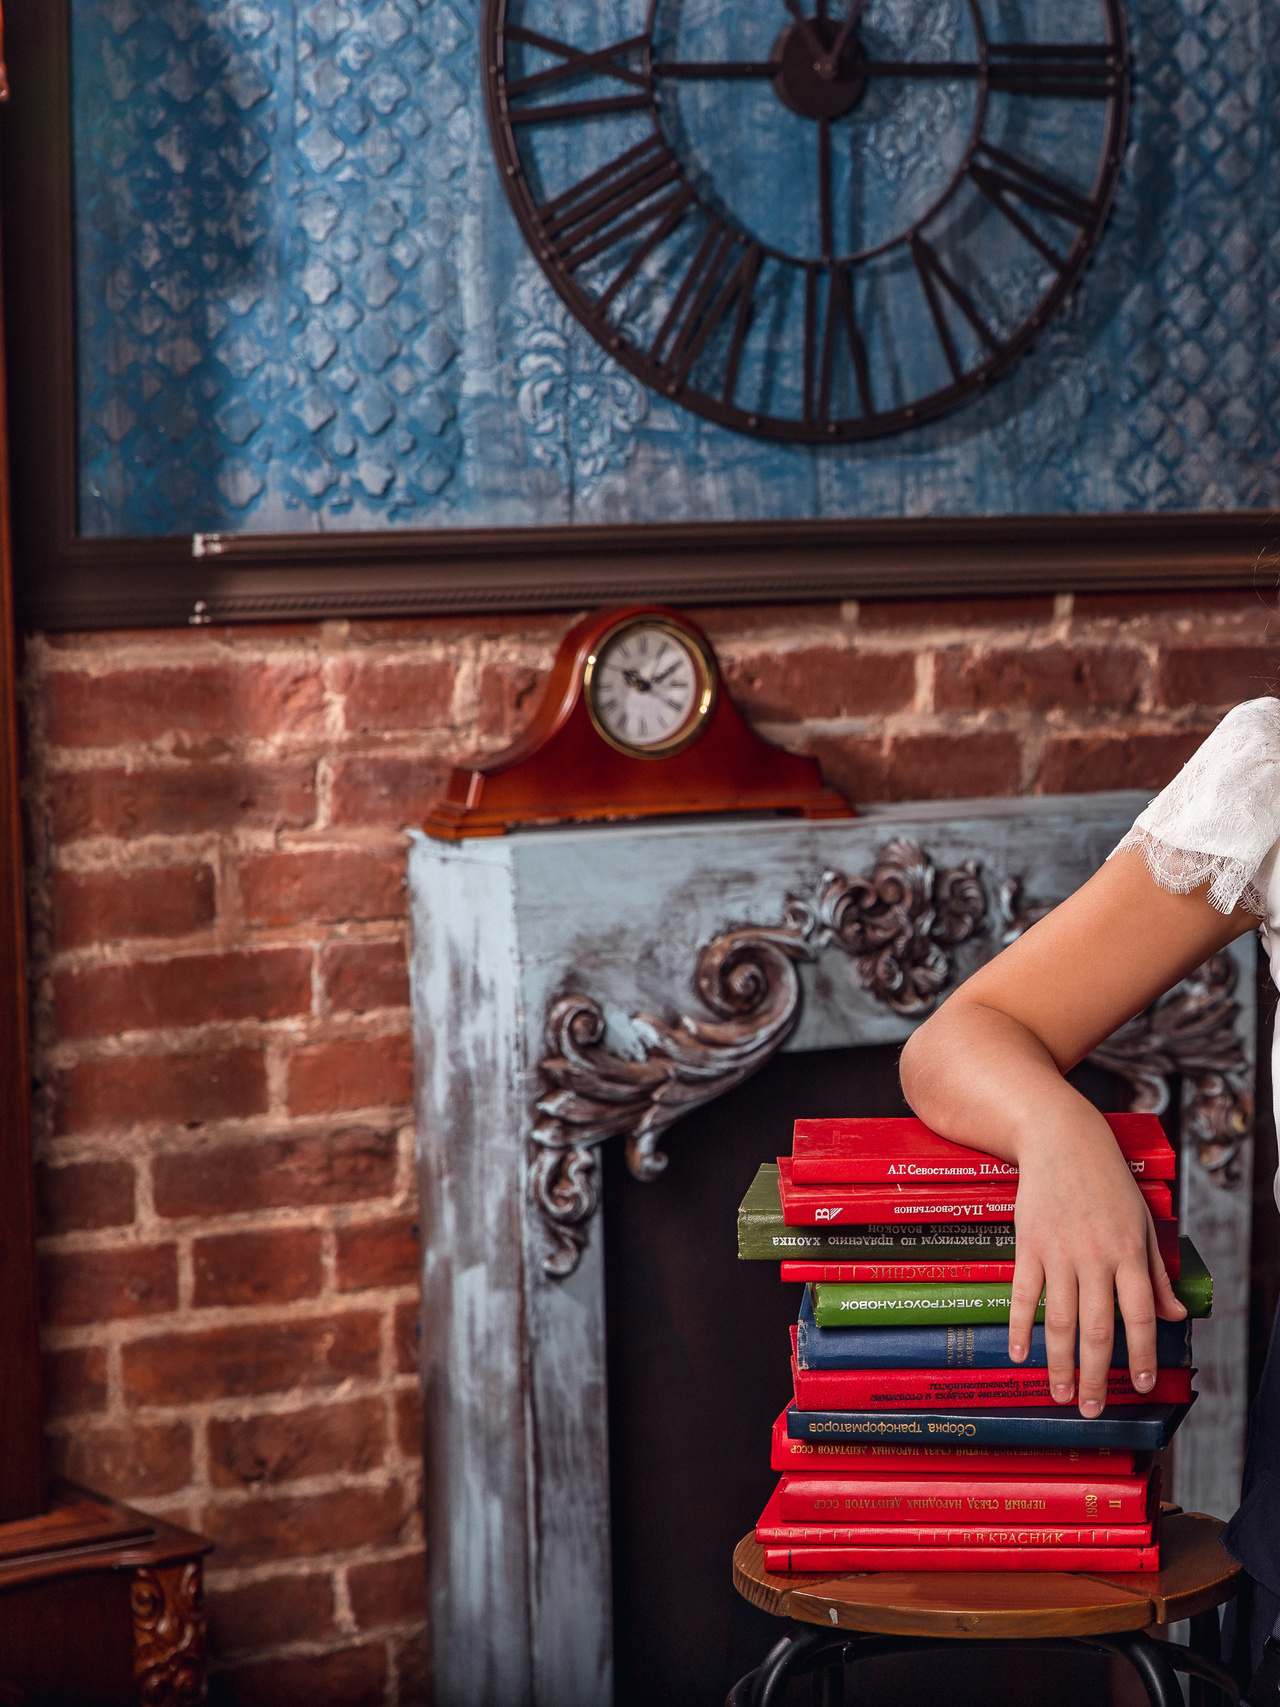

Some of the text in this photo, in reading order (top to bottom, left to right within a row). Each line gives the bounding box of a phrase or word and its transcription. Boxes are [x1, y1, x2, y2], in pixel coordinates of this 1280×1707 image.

[894, 1204, 983, 1216] П.А.Севостьянов
[867, 1225, 1010, 1234] химических волокон
[772, 1234, 1015, 1247] ый практикум по прядению хлопка
[840, 1298, 983, 1311] ЭЛЕКТРОУСТАНОВОК
[977, 1387, 1051, 1399] ционирование
[808, 1420, 977, 1437] Сборка трансформаторов
[790, 1444, 814, 1454] СССР
[814, 1497, 1046, 1510] ПЕРВЫЙ СЪЕЗД НАРОДНЫХ ДЕПУТАТОВ СССР
[1085, 1494, 1098, 1518] 1989
